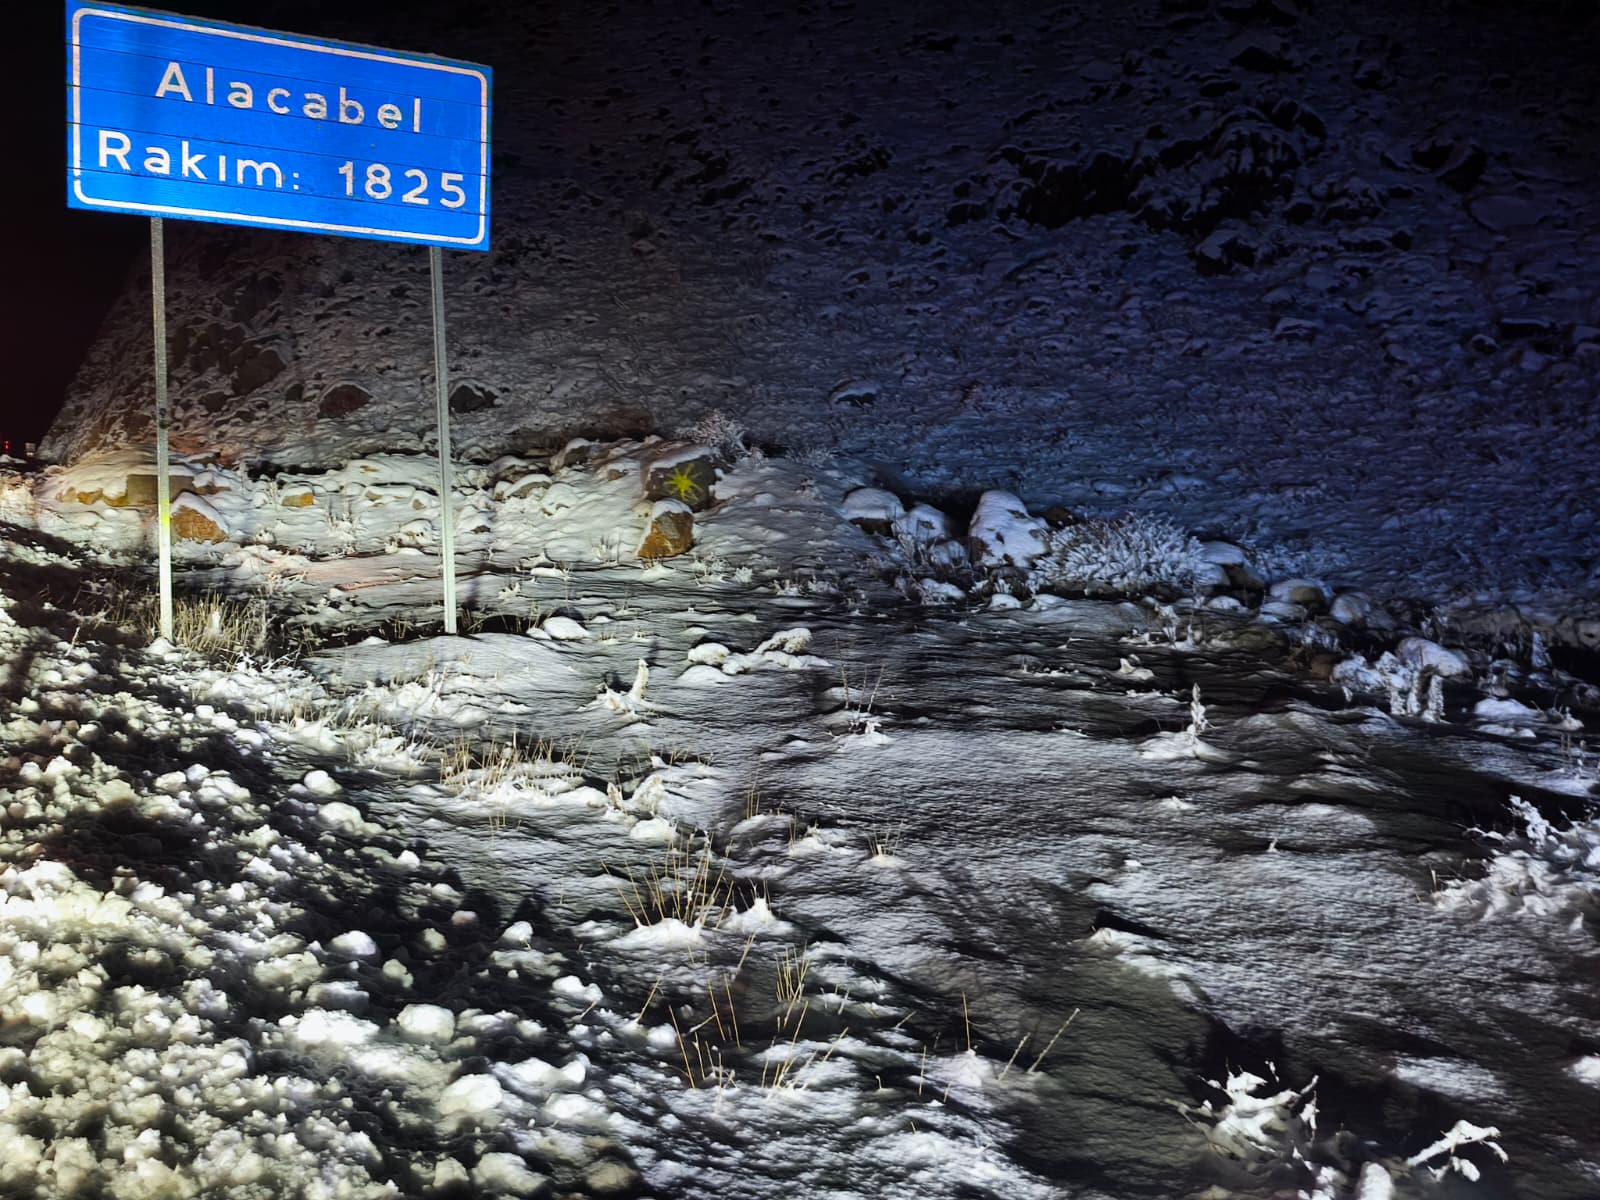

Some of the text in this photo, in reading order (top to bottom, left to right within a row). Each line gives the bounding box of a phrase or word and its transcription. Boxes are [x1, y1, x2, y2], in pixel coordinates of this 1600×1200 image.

[155, 61, 421, 133] Alacabel
[98, 129, 466, 209] Rakım: 1825
